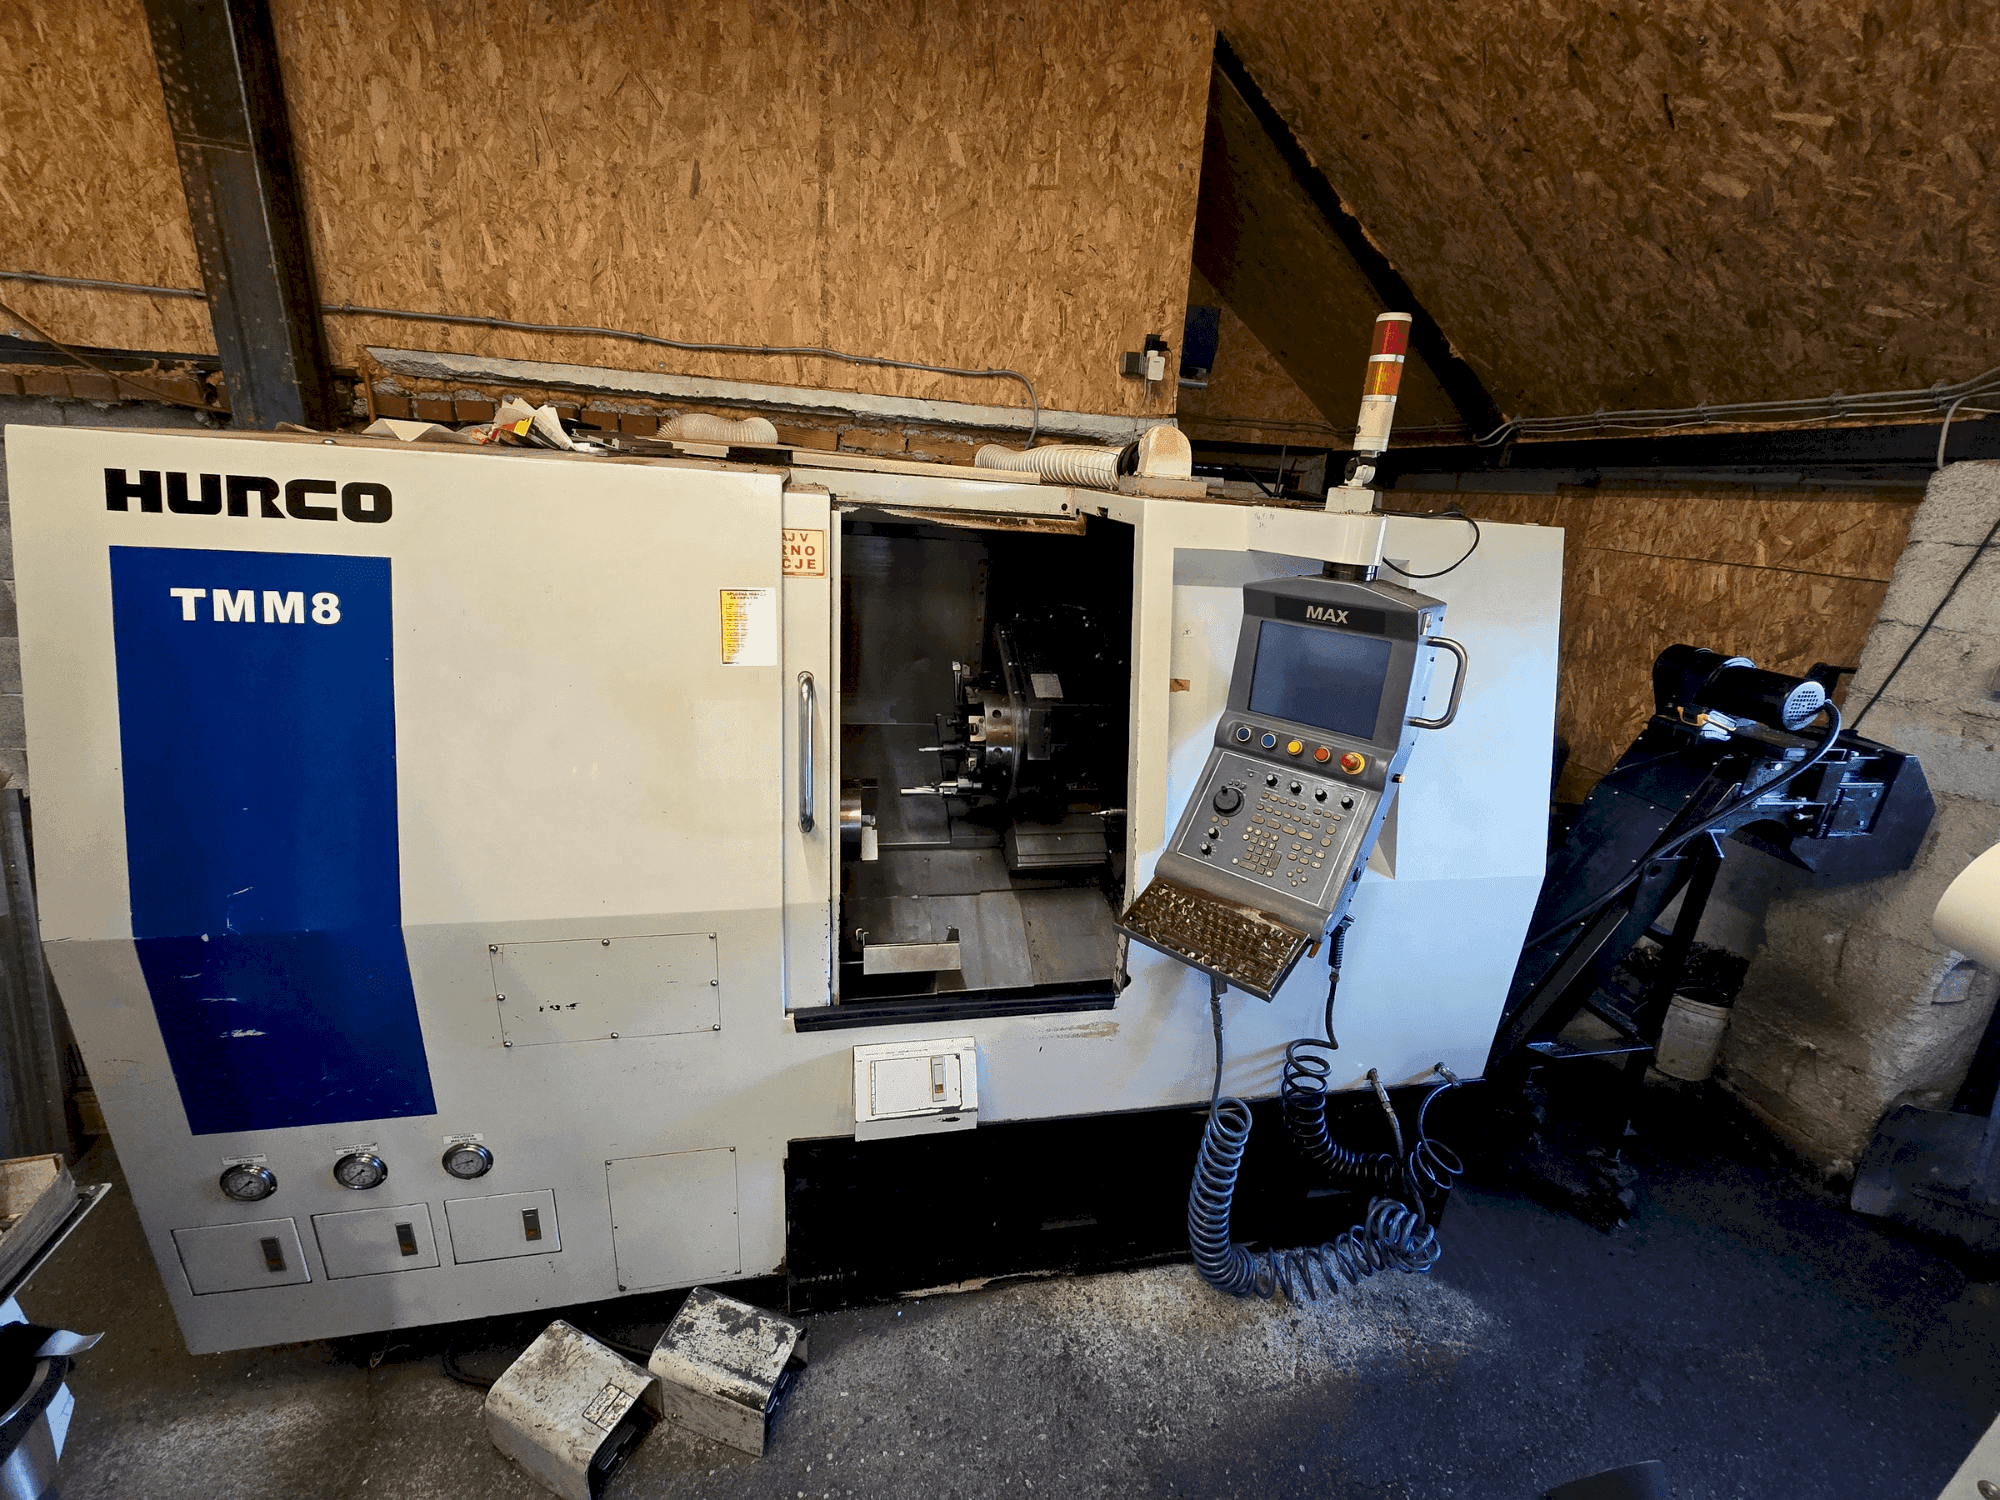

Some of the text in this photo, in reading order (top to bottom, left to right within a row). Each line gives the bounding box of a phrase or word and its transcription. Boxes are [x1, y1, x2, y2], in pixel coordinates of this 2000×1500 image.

[104, 467, 393, 523] HURCO
[800, 533, 808, 542] V
[170, 587, 342, 625] TMM8
[1306, 605, 1349, 624] MAX
